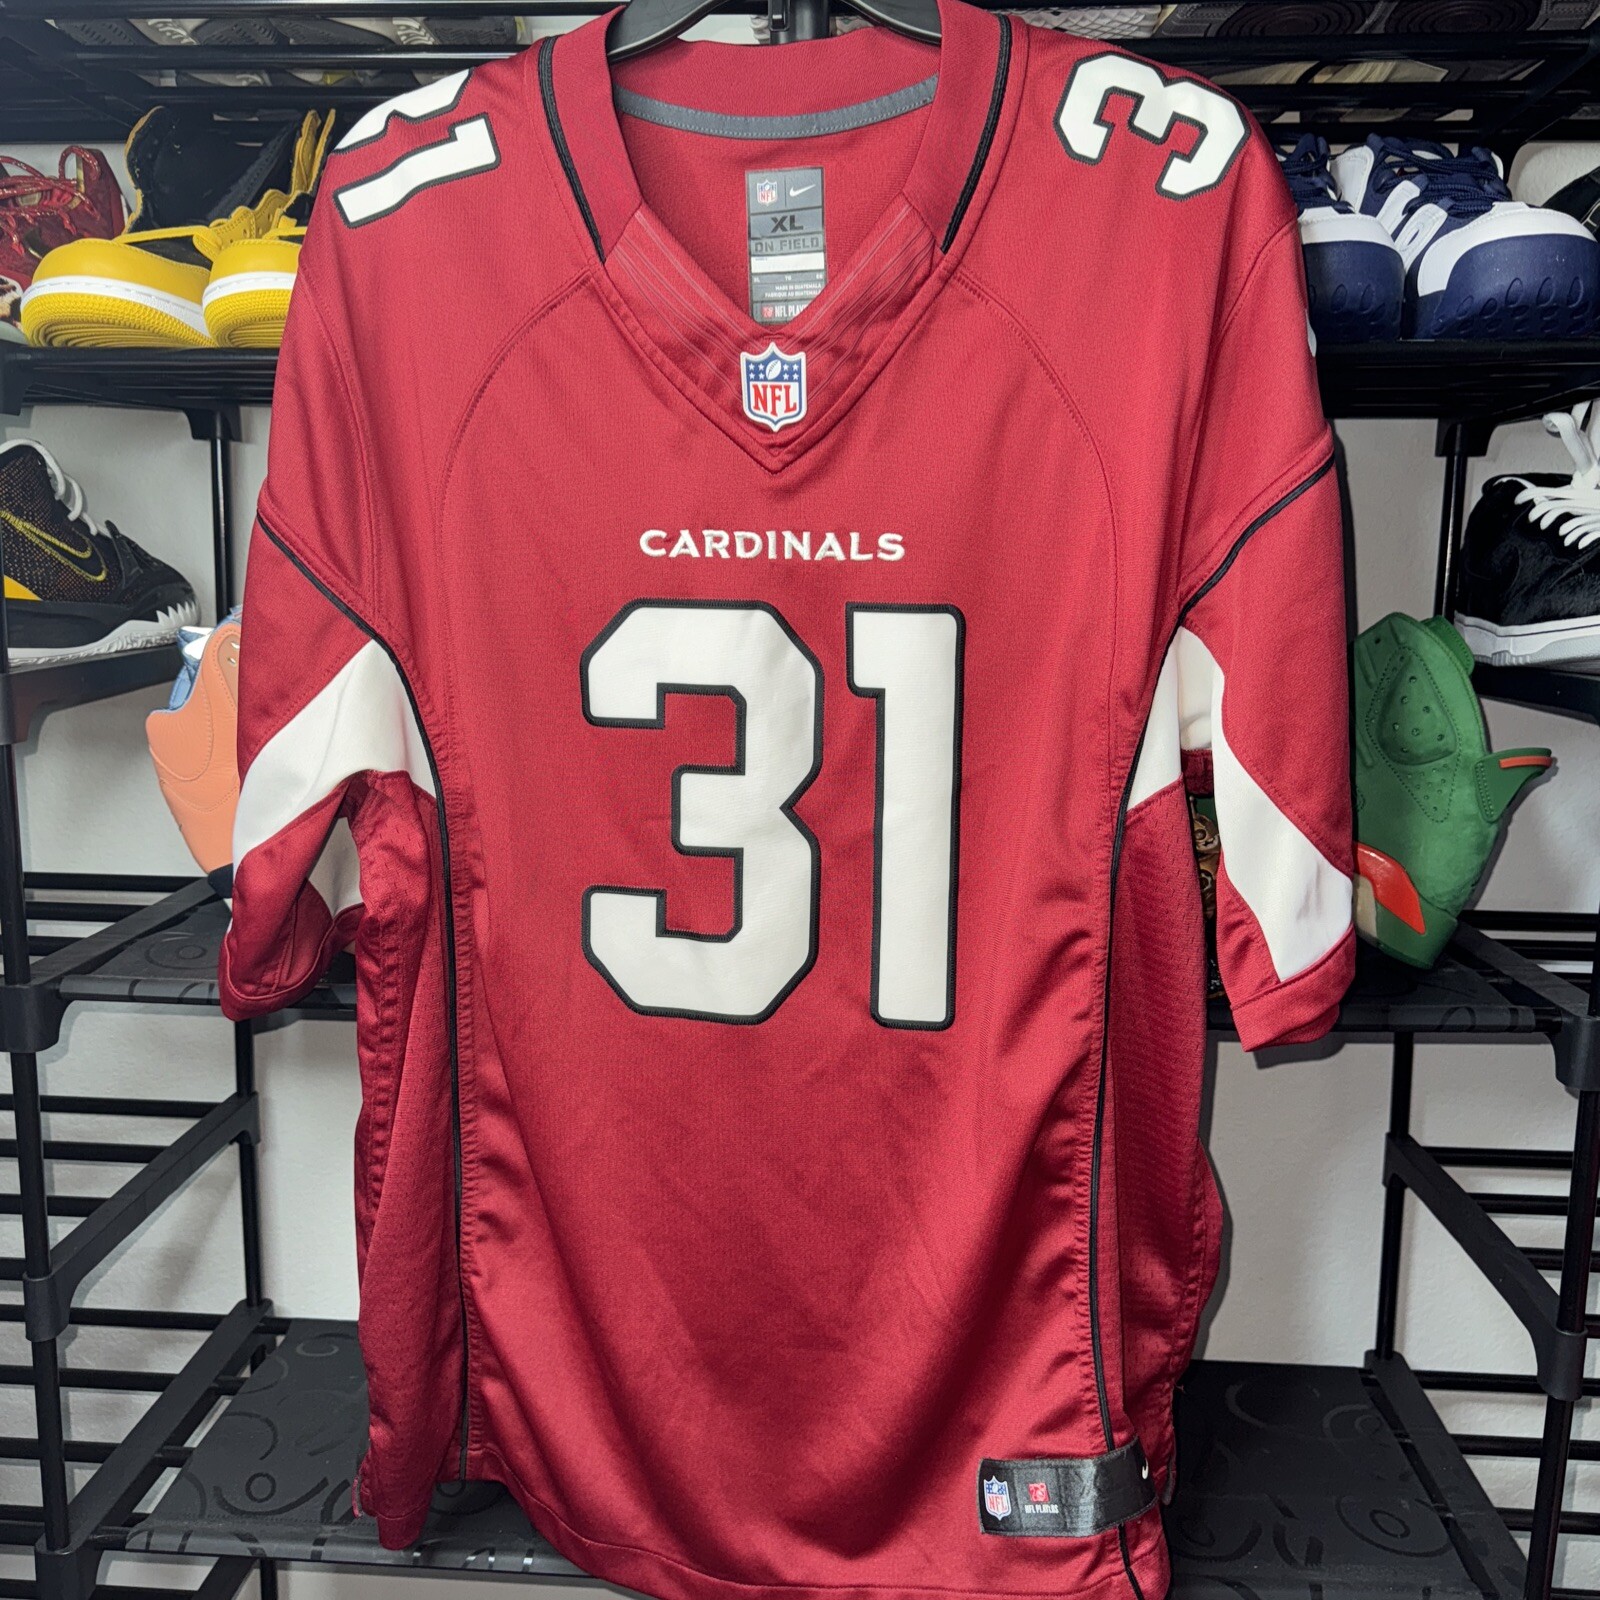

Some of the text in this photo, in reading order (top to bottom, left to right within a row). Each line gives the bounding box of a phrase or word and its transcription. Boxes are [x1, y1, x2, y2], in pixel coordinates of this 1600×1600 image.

[771, 215, 804, 233] XL
[754, 237, 819, 253] ON FIELD
[775, 305, 787, 318] NFL
[752, 384, 797, 417] NFL
[639, 529, 905, 561] CARDINALS
[580, 597, 966, 1031] 31
[988, 1495, 1008, 1511] NFL
